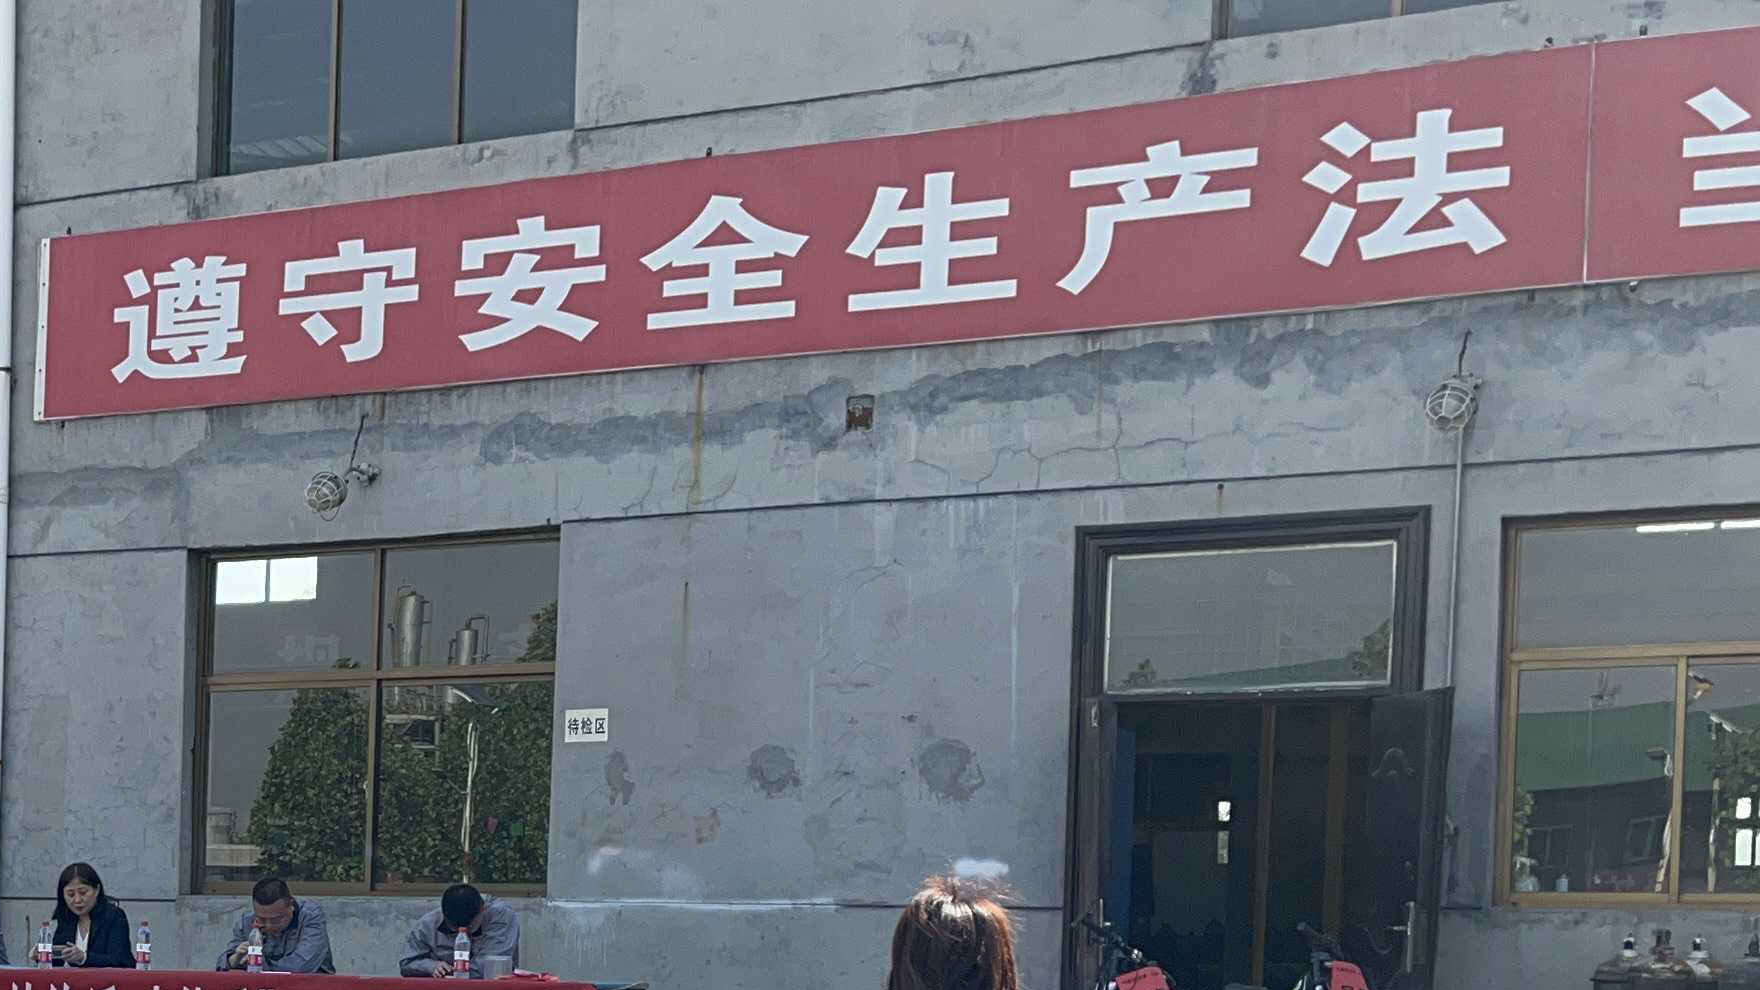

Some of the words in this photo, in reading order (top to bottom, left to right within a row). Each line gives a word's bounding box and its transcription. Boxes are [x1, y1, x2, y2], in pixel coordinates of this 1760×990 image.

[111, 109, 1511, 384] 遵守安全生产法
[568, 717, 606, 735] 待检区
